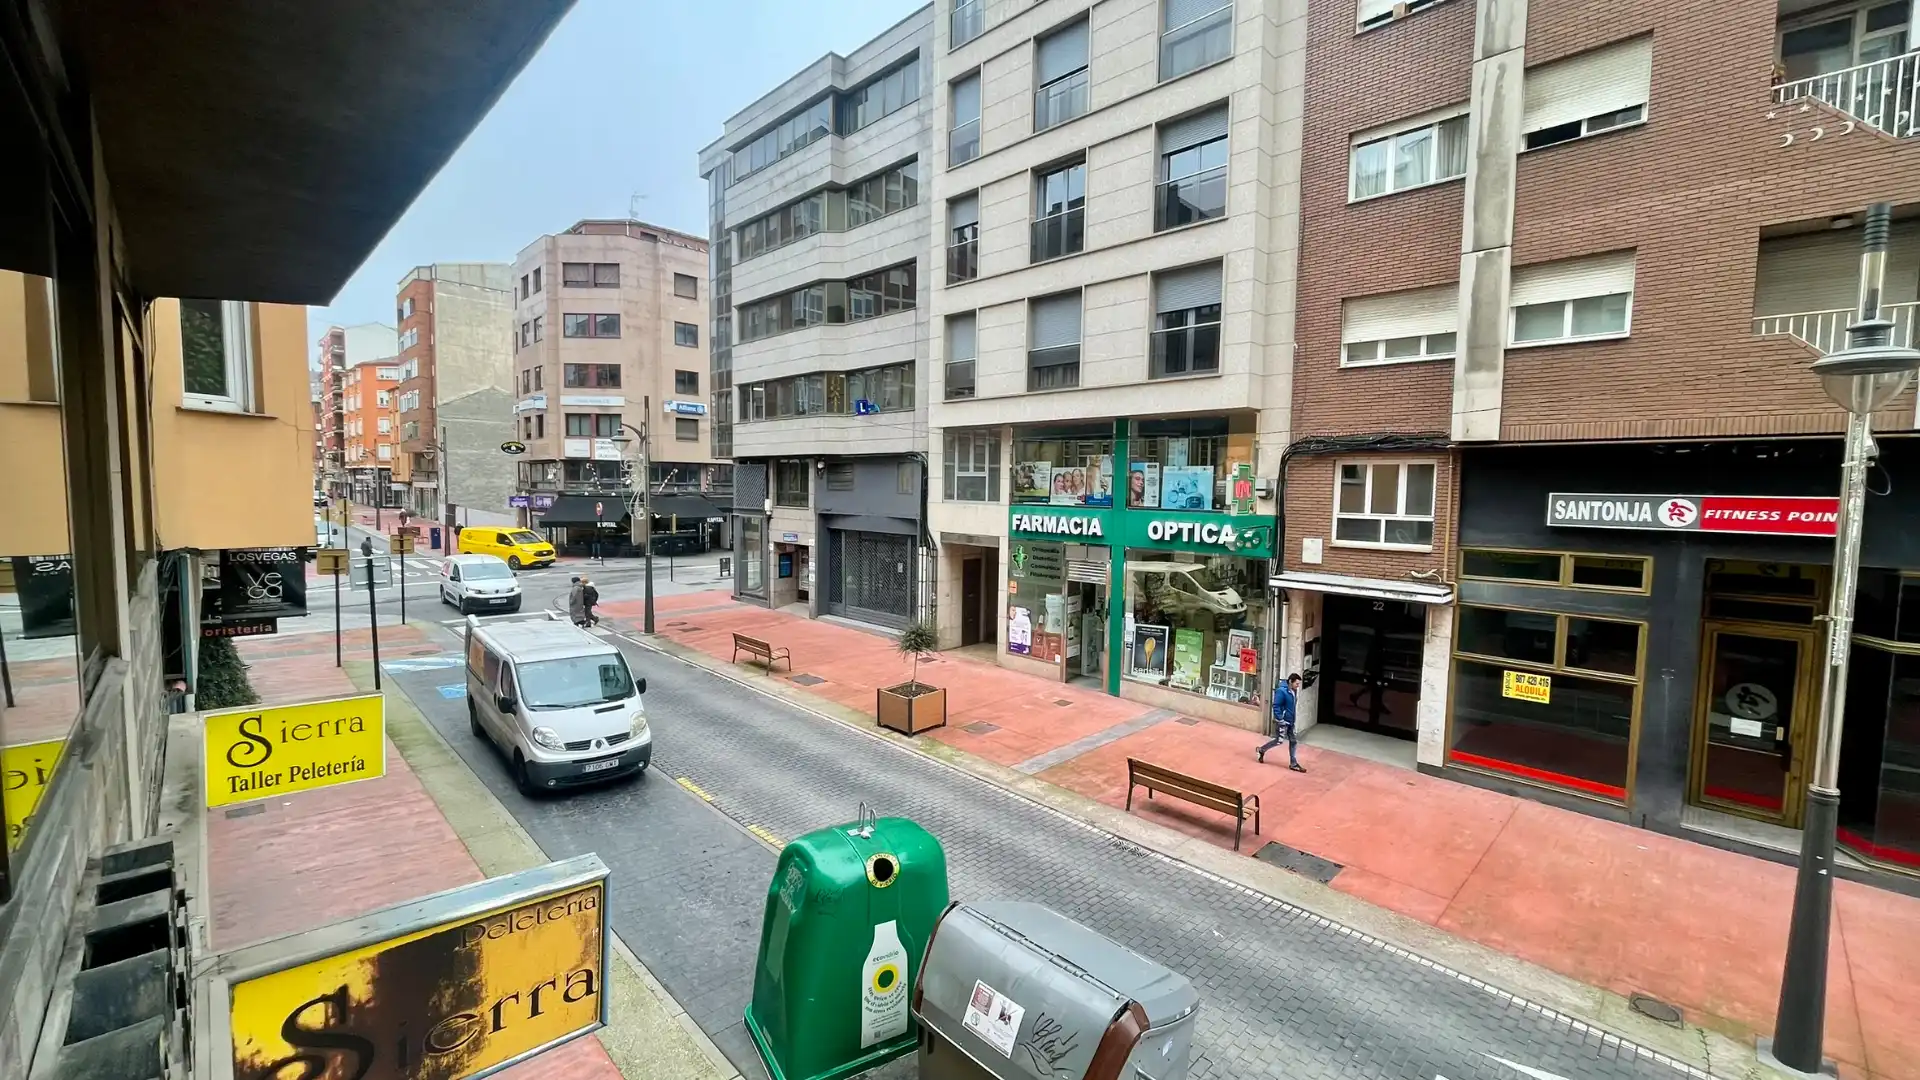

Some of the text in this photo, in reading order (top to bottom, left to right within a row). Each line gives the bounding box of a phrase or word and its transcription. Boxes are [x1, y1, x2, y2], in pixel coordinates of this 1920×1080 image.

[1555, 499, 1652, 522] SANTONJA
[1704, 509, 1838, 523] FITNESS POIN
[1012, 513, 1103, 536] FARMACIA
[1147, 520, 1237, 545] OPTICA
[1372, 601, 1385, 611] 22
[226, 714, 366, 768] Sierra
[227, 755, 365, 794] Taller Peletería
[458, 893, 597, 949] Peletería
